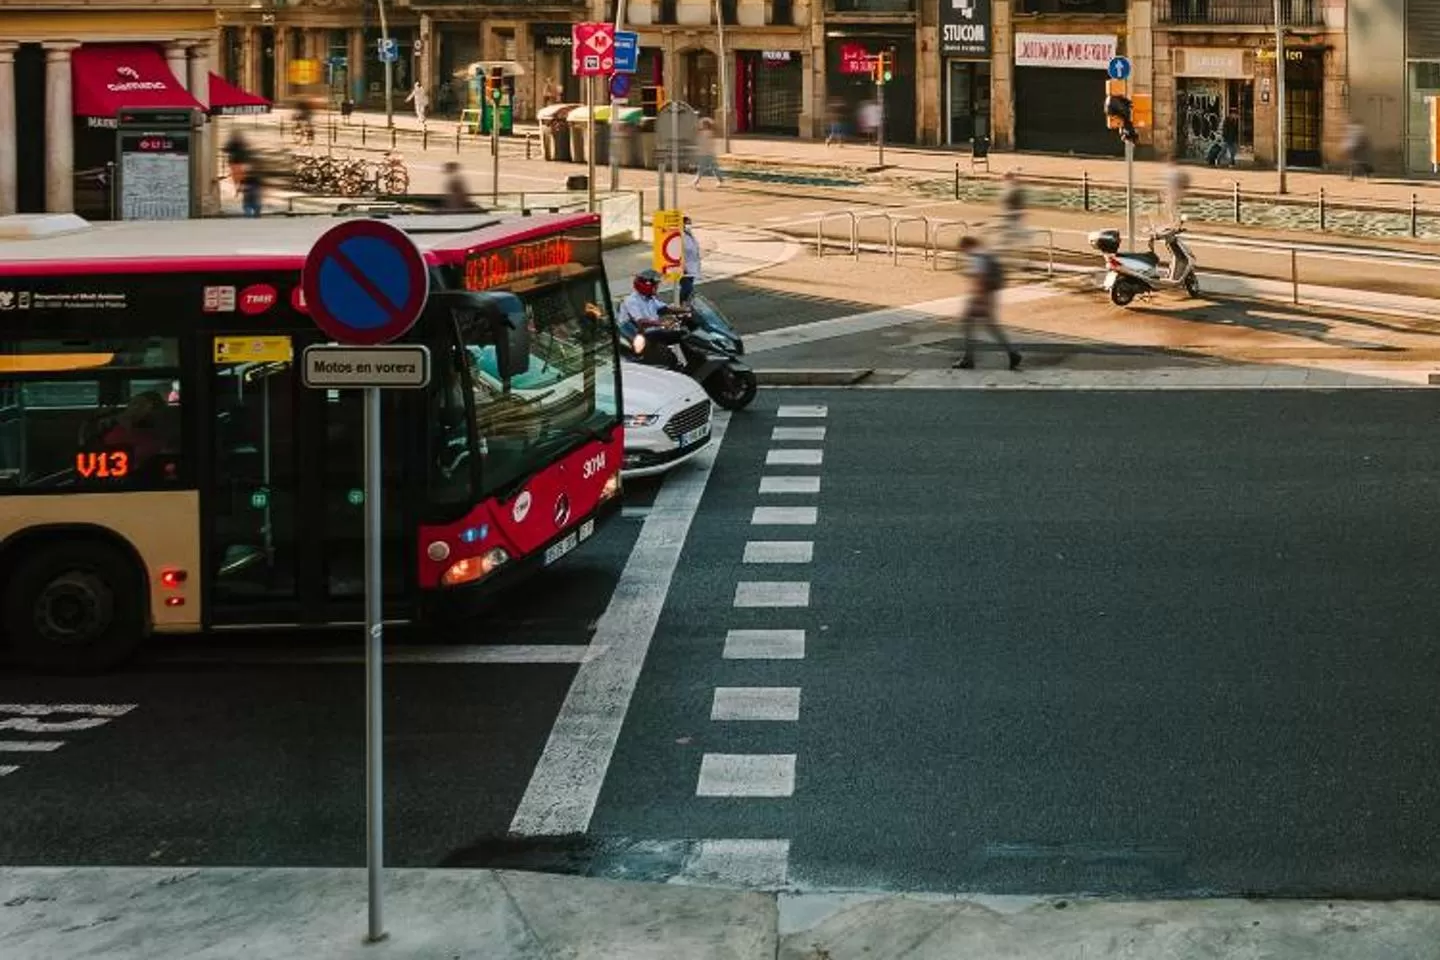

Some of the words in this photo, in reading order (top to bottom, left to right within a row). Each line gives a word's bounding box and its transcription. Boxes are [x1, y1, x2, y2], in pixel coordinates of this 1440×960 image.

[944, 24, 985, 41] STUCOM
[314, 361, 352, 374] Motos
[356, 364, 372, 374] en
[375, 364, 416, 374] vorera
[76, 451, 128, 477] V13
